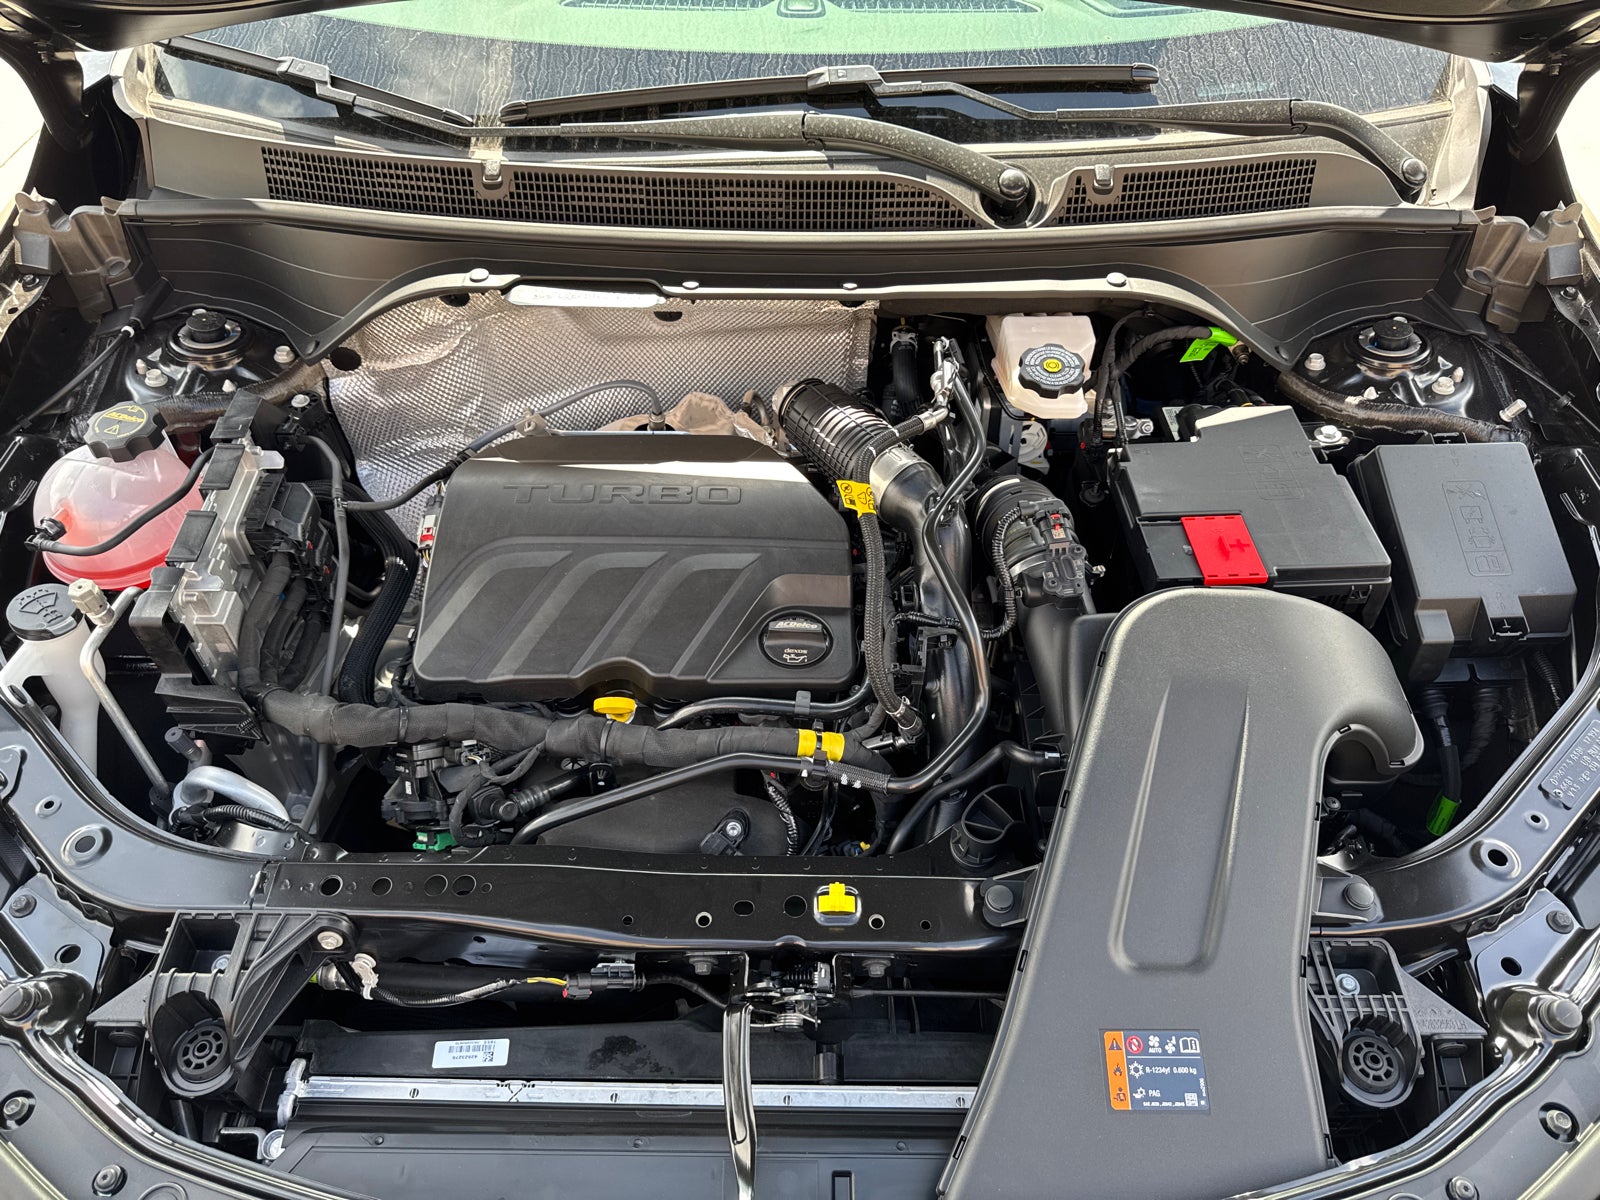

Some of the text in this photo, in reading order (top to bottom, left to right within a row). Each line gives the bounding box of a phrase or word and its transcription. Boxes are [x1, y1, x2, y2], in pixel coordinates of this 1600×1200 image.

[504, 484, 742, 505] TURBO
[775, 621, 818, 629] ACDelco
[1145, 1066, 1171, 1074] R-1234yf
[1190, 1066, 1197, 1075] kg
[1148, 1089, 1161, 1097] PAG
